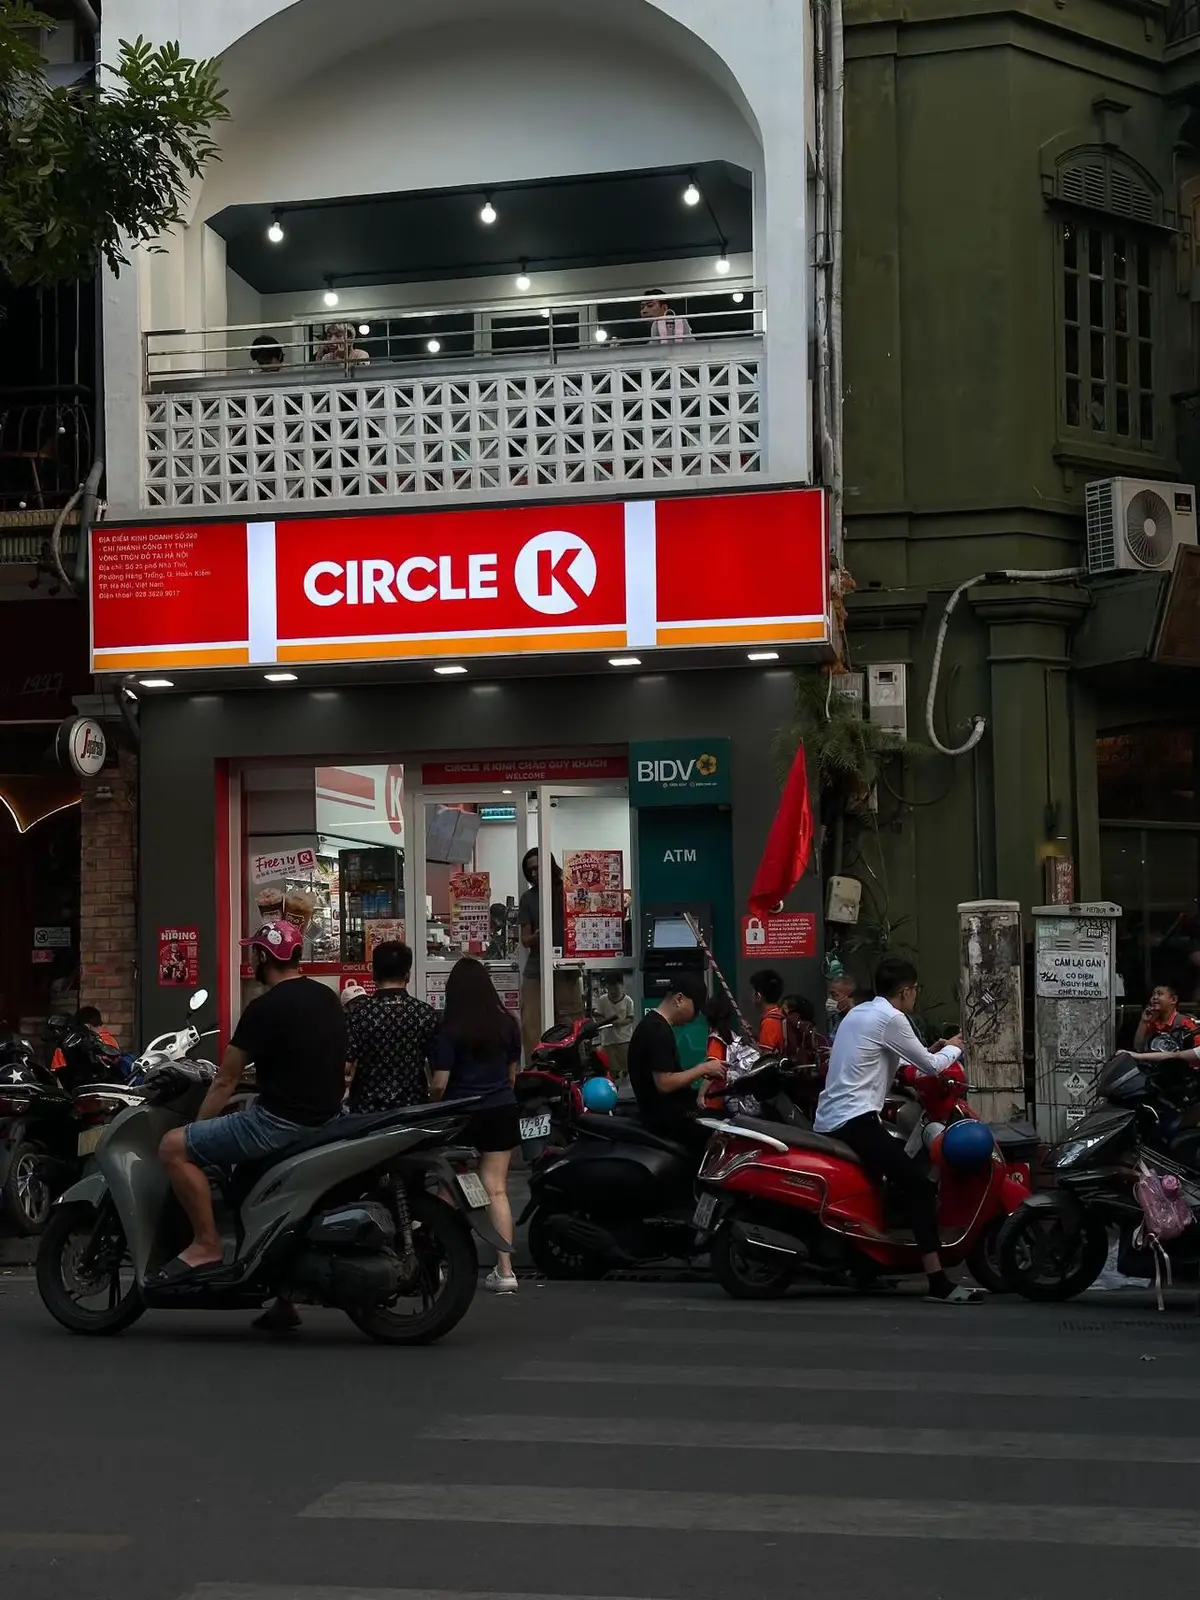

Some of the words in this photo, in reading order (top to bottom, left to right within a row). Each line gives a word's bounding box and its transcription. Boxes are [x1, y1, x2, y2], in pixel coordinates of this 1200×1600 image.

[303, 553, 498, 607] CIRCLE
[525, 538, 597, 614] K
[446, 764, 479, 772] CIRCLE
[638, 759, 696, 782] BIDV
[505, 772, 546, 781] WELCOME
[663, 849, 697, 863] ATM
[255, 856, 280, 872] Free
[161, 932, 197, 941] HIRING
